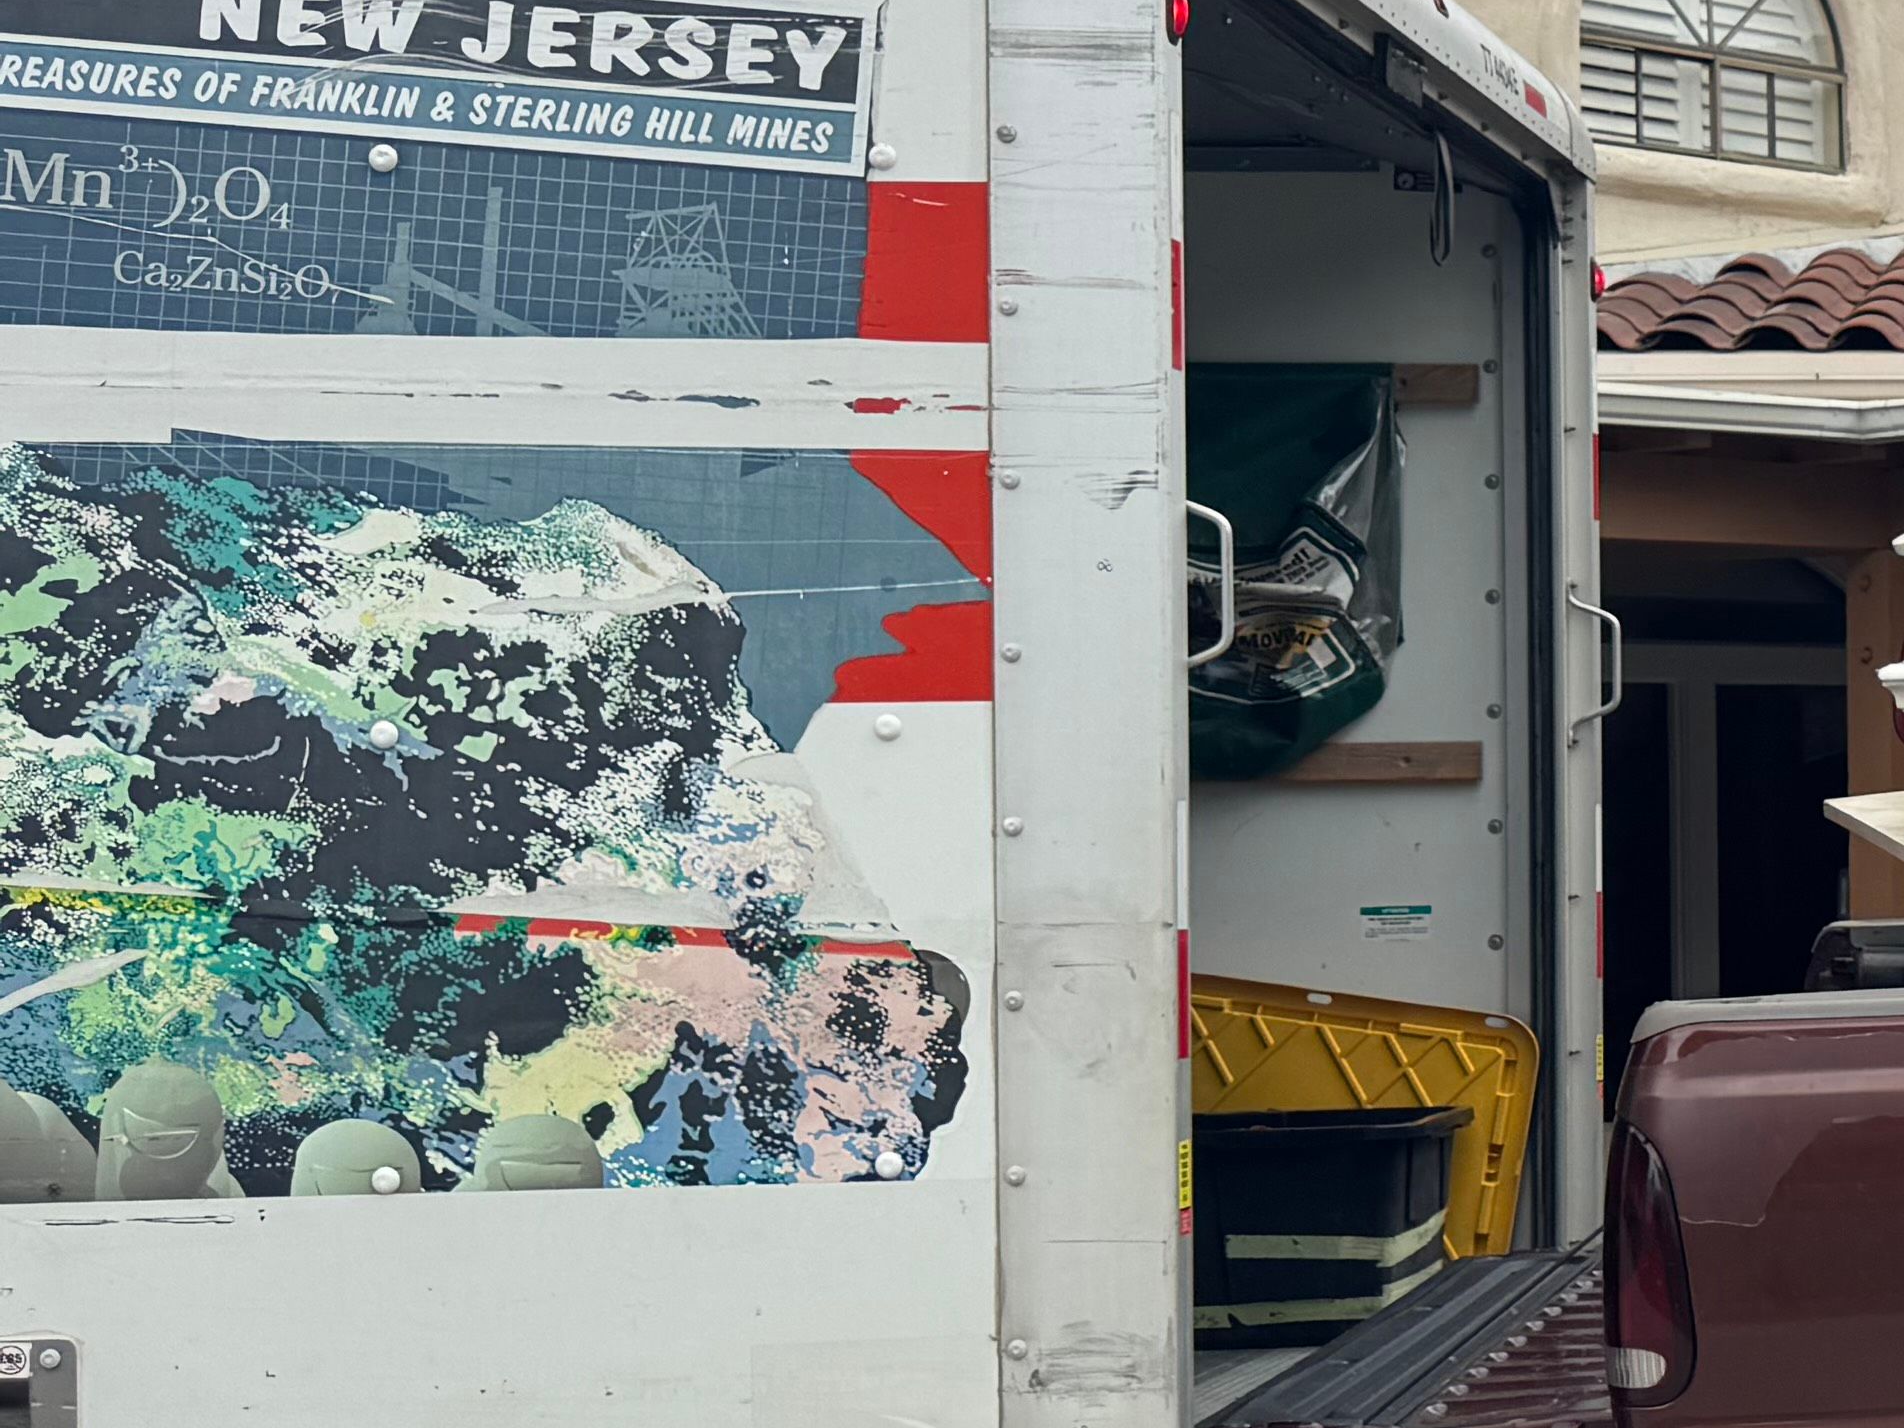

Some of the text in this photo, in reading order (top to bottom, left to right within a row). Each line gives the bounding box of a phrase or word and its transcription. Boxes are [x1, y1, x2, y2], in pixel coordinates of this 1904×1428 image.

[461, 0, 848, 91] JERSEY
[0, 53, 835, 154] REASURES OF FRANKLIN & STERLING HILL MINES
